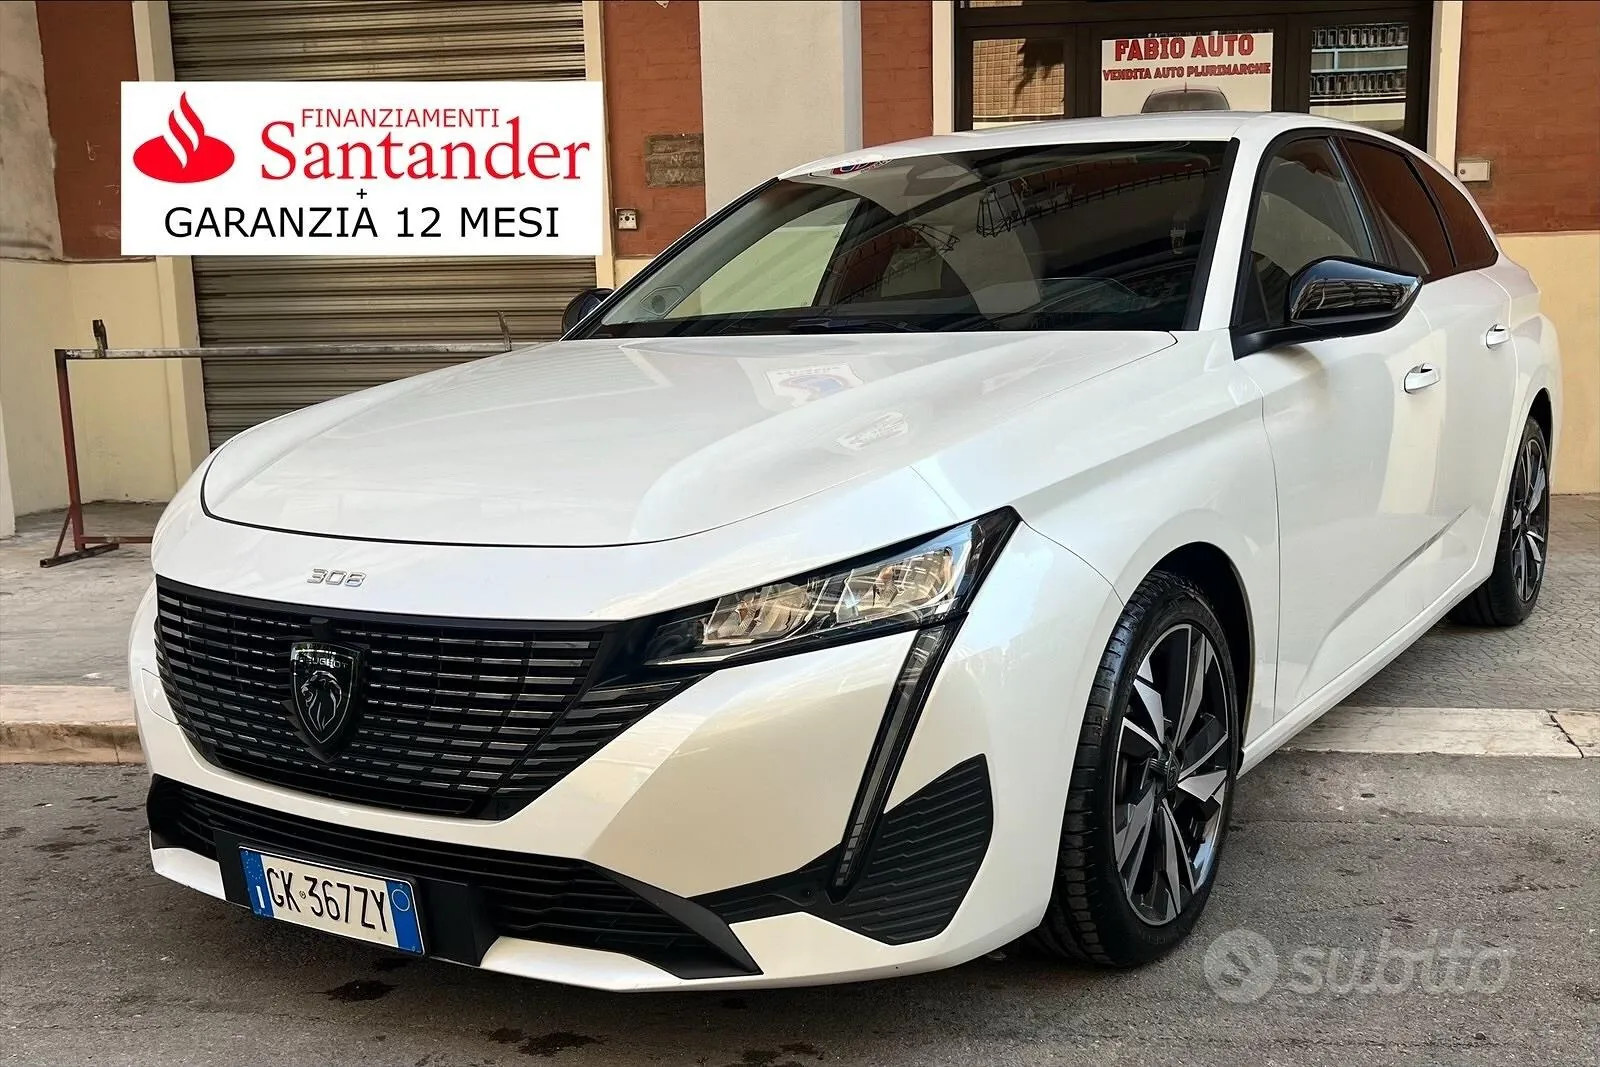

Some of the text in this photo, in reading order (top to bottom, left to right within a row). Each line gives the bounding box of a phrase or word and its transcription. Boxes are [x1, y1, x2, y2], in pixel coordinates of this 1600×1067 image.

[1114, 34, 1254, 61] FABIO AUTO
[1102, 62, 1272, 81] VENDITA AUTO PLURIMARCHE
[306, 568, 367, 587] 308
